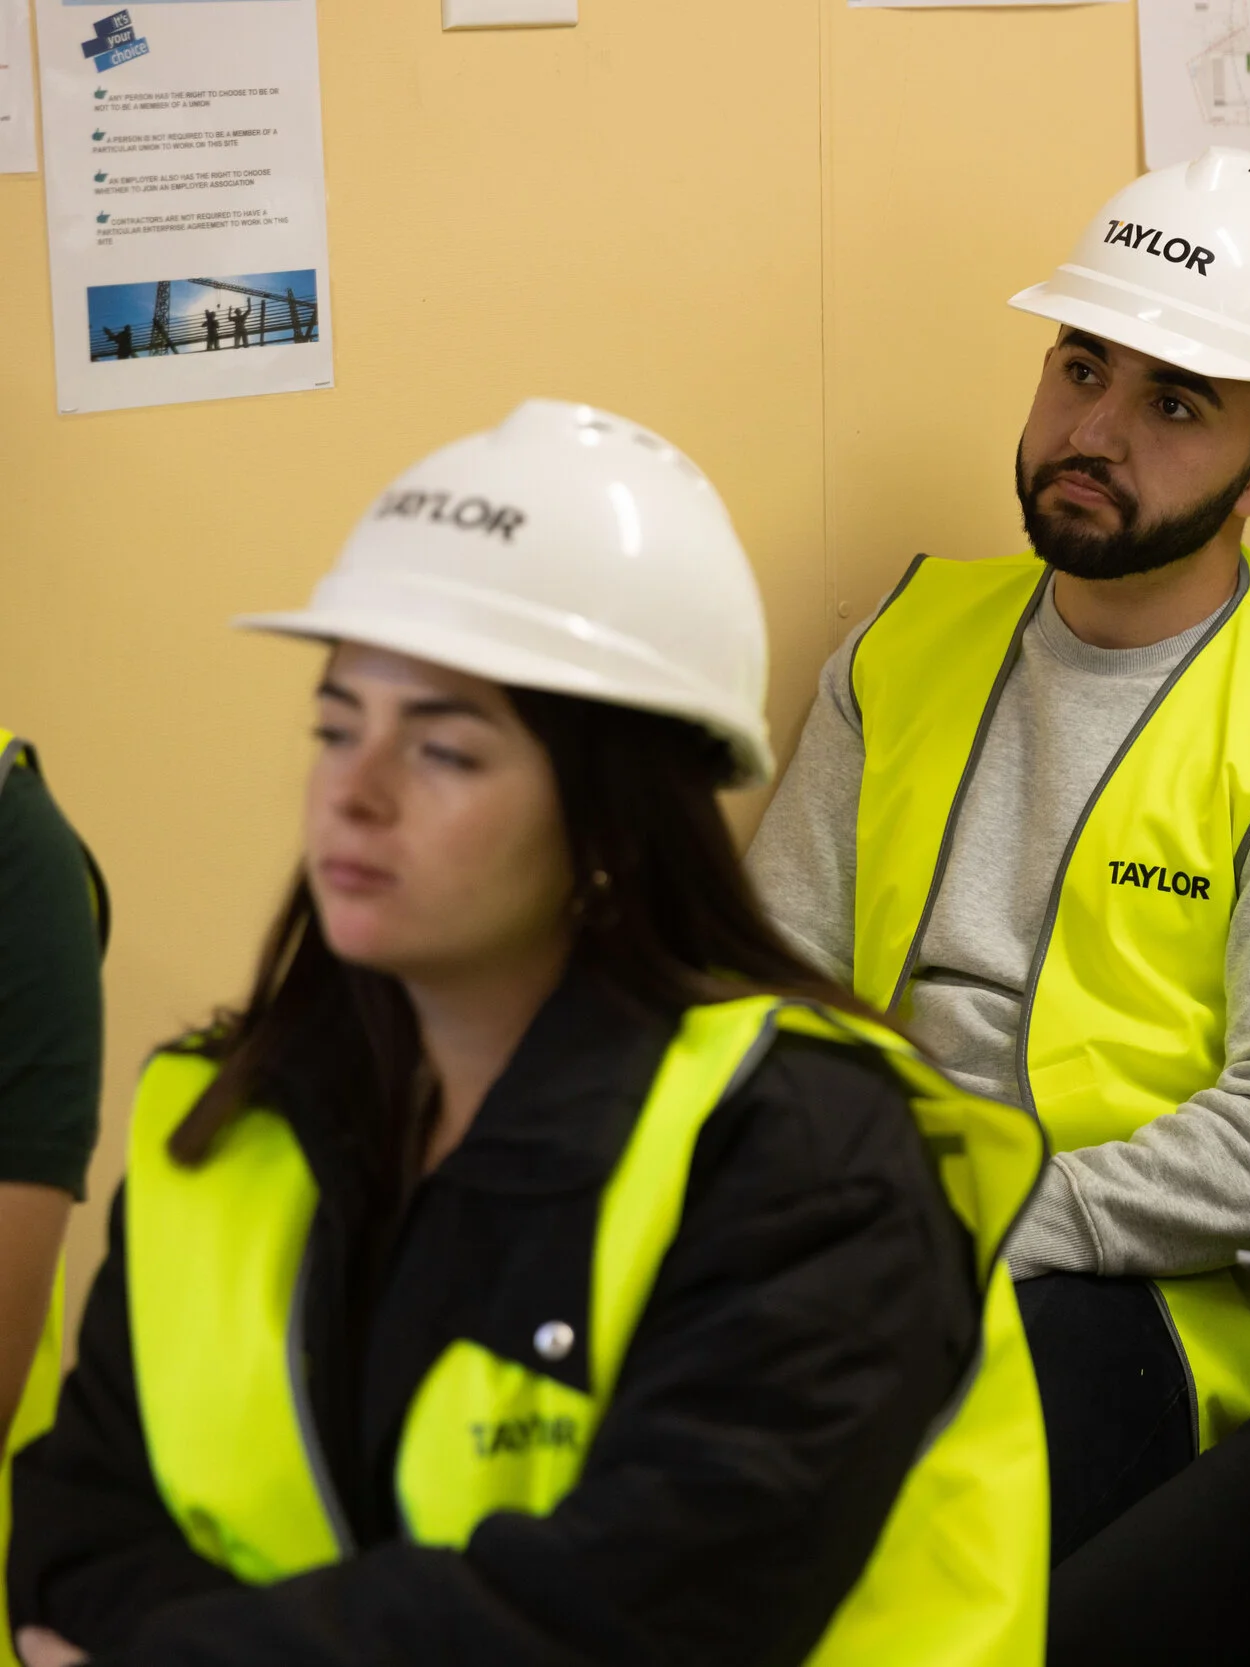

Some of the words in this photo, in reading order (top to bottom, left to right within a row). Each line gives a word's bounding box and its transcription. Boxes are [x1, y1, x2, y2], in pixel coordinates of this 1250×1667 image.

[114, 14, 129, 28] It's
[108, 31, 131, 48] your
[112, 43, 147, 64] choice
[1104, 218, 1215, 277] TAYLOR
[1108, 860, 1211, 901] TAYLOR
